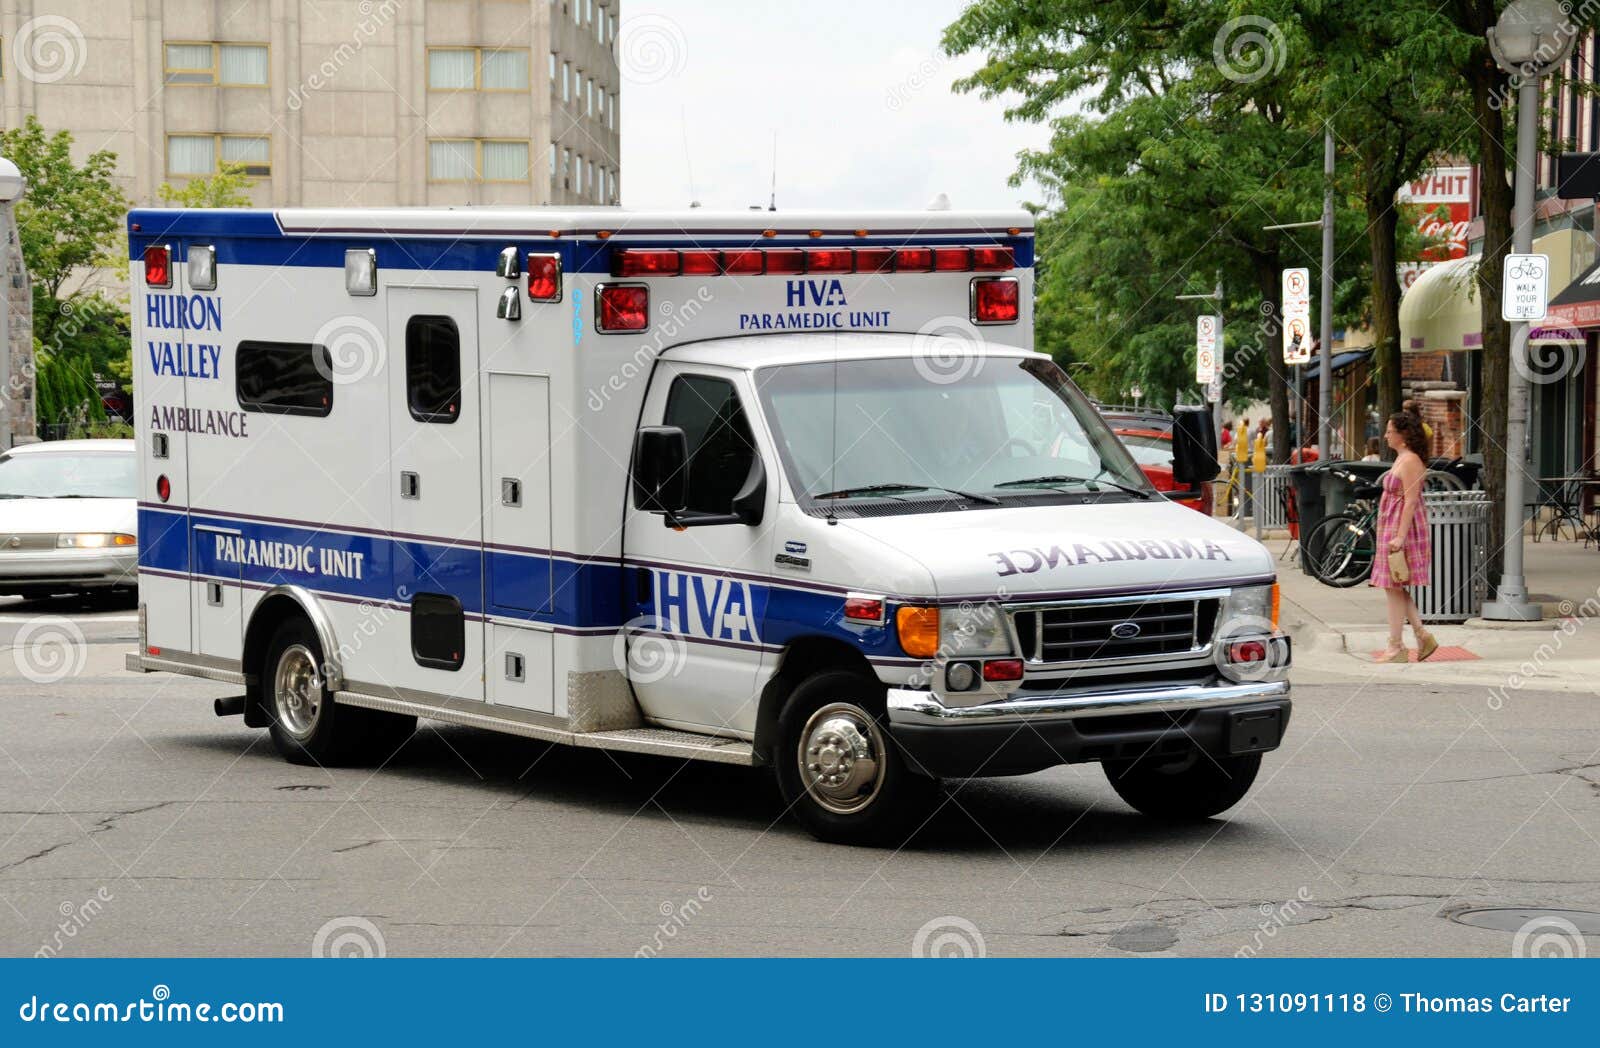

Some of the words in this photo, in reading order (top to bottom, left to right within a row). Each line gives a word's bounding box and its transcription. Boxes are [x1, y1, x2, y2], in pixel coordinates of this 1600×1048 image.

[786, 279, 848, 307] HVA
[1516, 283, 1537, 292] WALK
[1516, 294, 1537, 303] YOUR
[146, 293, 222, 332] HURON
[740, 312, 843, 330] PARAMEDIC
[849, 311, 891, 328] UNIT
[1516, 305, 1536, 314] BIKE
[147, 341, 222, 379] VALLEY
[150, 405, 249, 438] AMBULANCE
[215, 534, 316, 573] PARAMEDIC
[319, 548, 364, 580] UNIT
[658, 571, 756, 643] HVA
